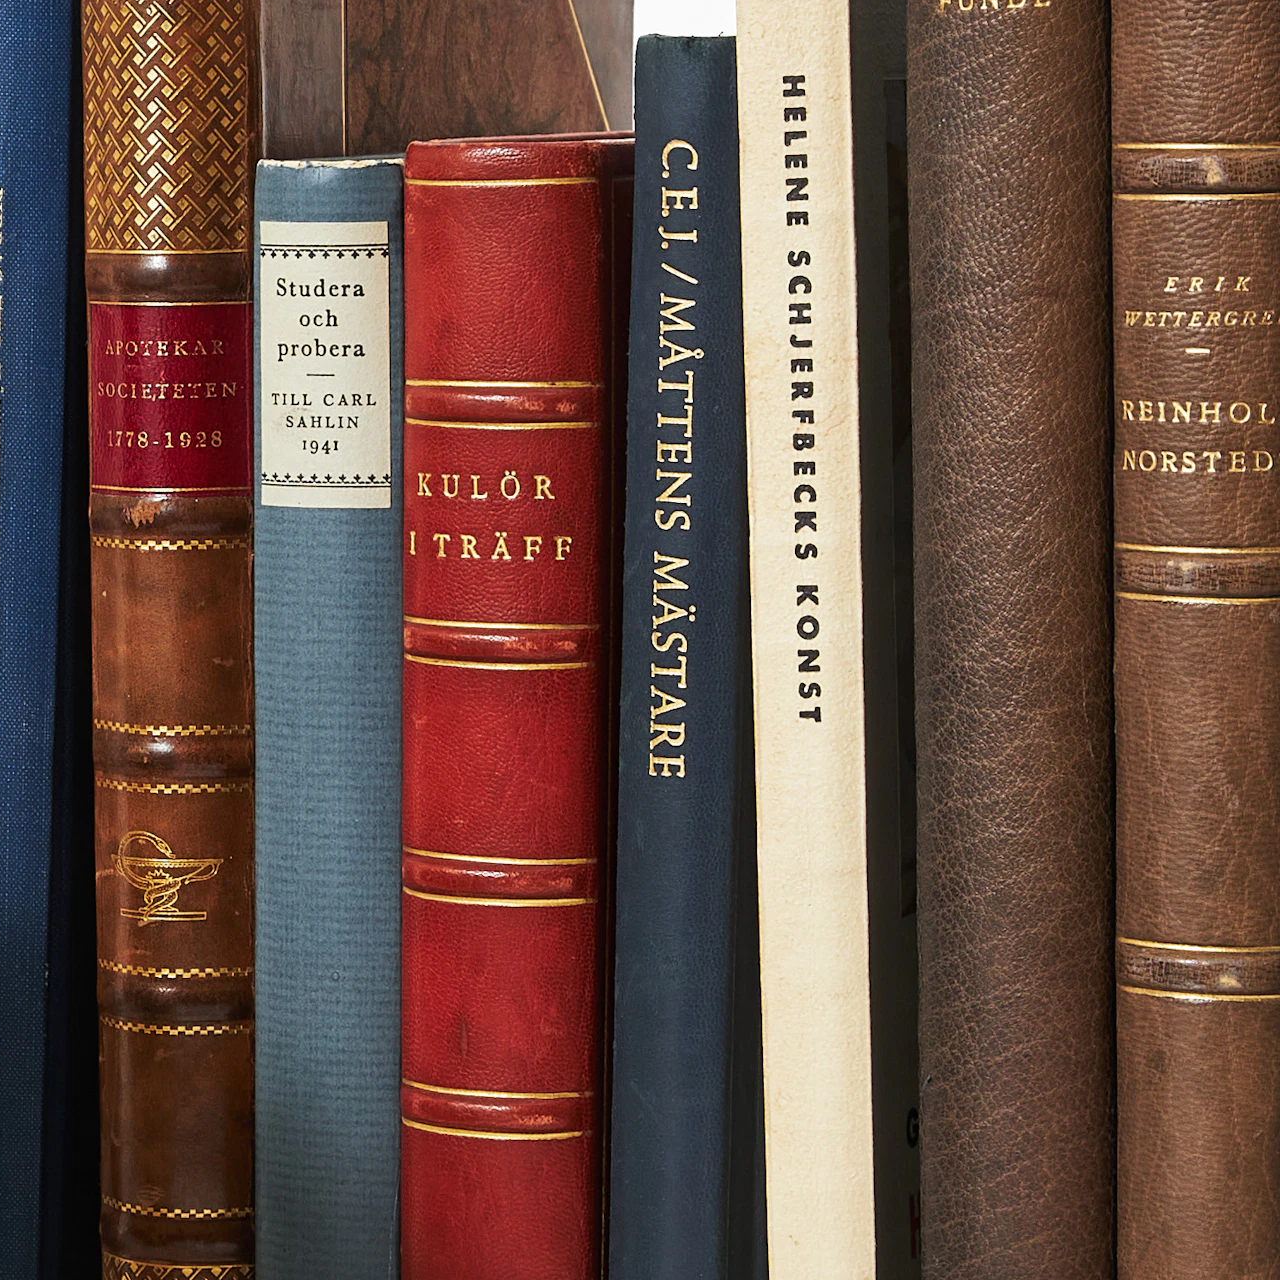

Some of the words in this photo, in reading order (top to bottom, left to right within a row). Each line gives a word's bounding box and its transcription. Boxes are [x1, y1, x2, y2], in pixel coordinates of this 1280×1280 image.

[782, 74, 810, 227] HELENE
[276, 277, 366, 299] Studera
[1164, 276, 1251, 292] ERIK
[299, 309, 339, 328] och
[1125, 310, 1280, 328] WETTERGRE
[277, 339, 366, 362] probera
[271, 393, 313, 407] TILL
[323, 393, 378, 407] CARL
[786, 250, 819, 560] SCHJERFBECKS
[285, 415, 360, 429] SAHLIN
[654, 292, 705, 531] MÅTTENS
[107, 429, 223, 449] 1778-1928
[302, 439, 340, 455] 1941
[417, 470, 556, 500] KULÖR
[433, 531, 573, 561] TRÄFF
[648, 550, 697, 778] MÄSTARE
[795, 584, 822, 723] KONST
